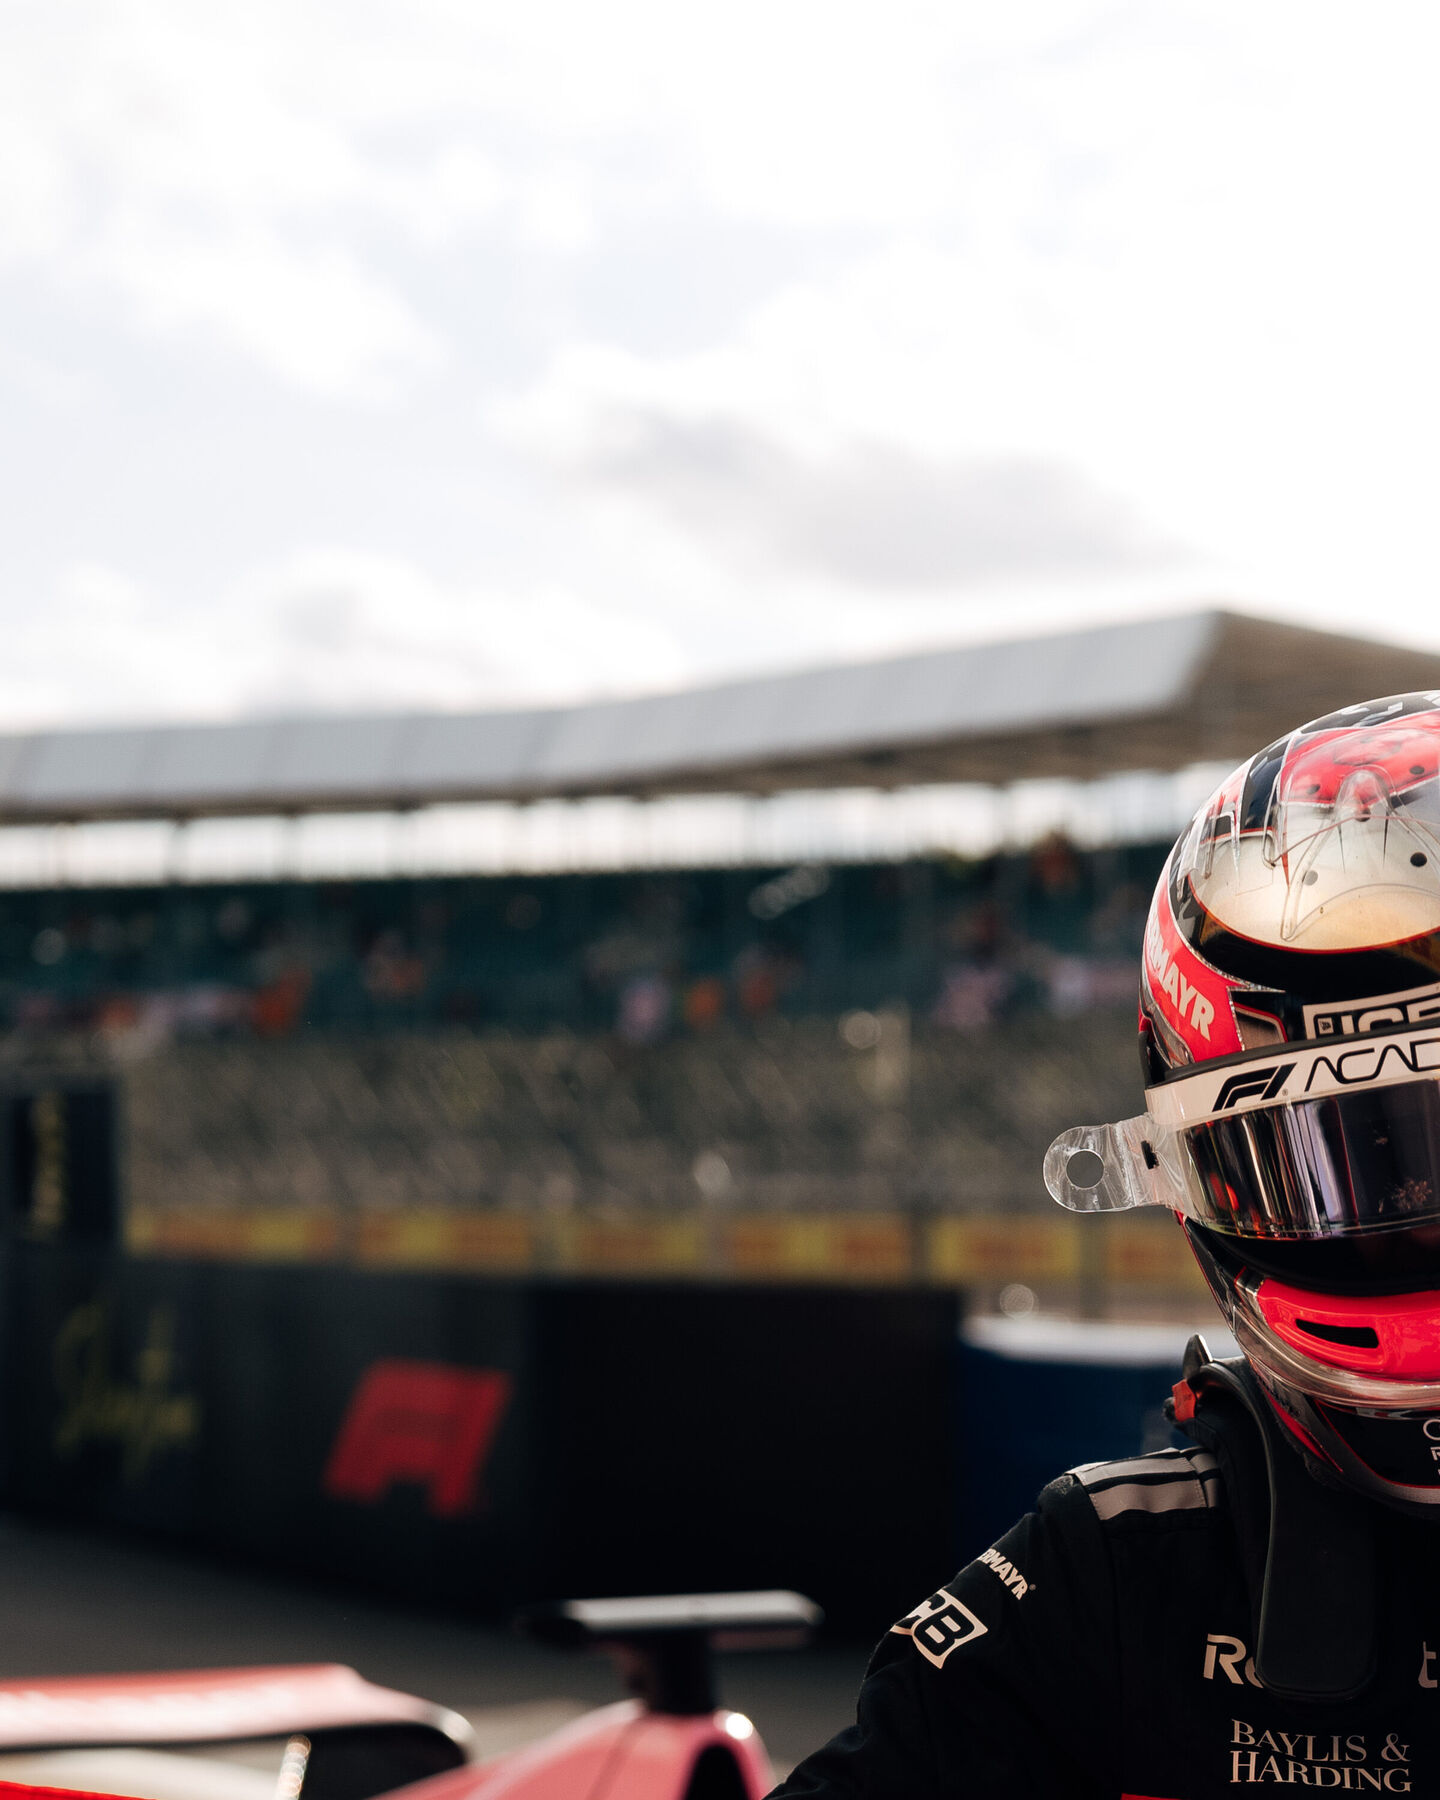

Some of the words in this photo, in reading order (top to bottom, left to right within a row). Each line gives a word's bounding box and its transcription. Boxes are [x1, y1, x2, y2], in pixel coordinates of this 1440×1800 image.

[1230, 1719, 1367, 1763] BAYLIS
[1380, 1733, 1411, 1762] &
[1230, 1750, 1413, 1793] HARDING
